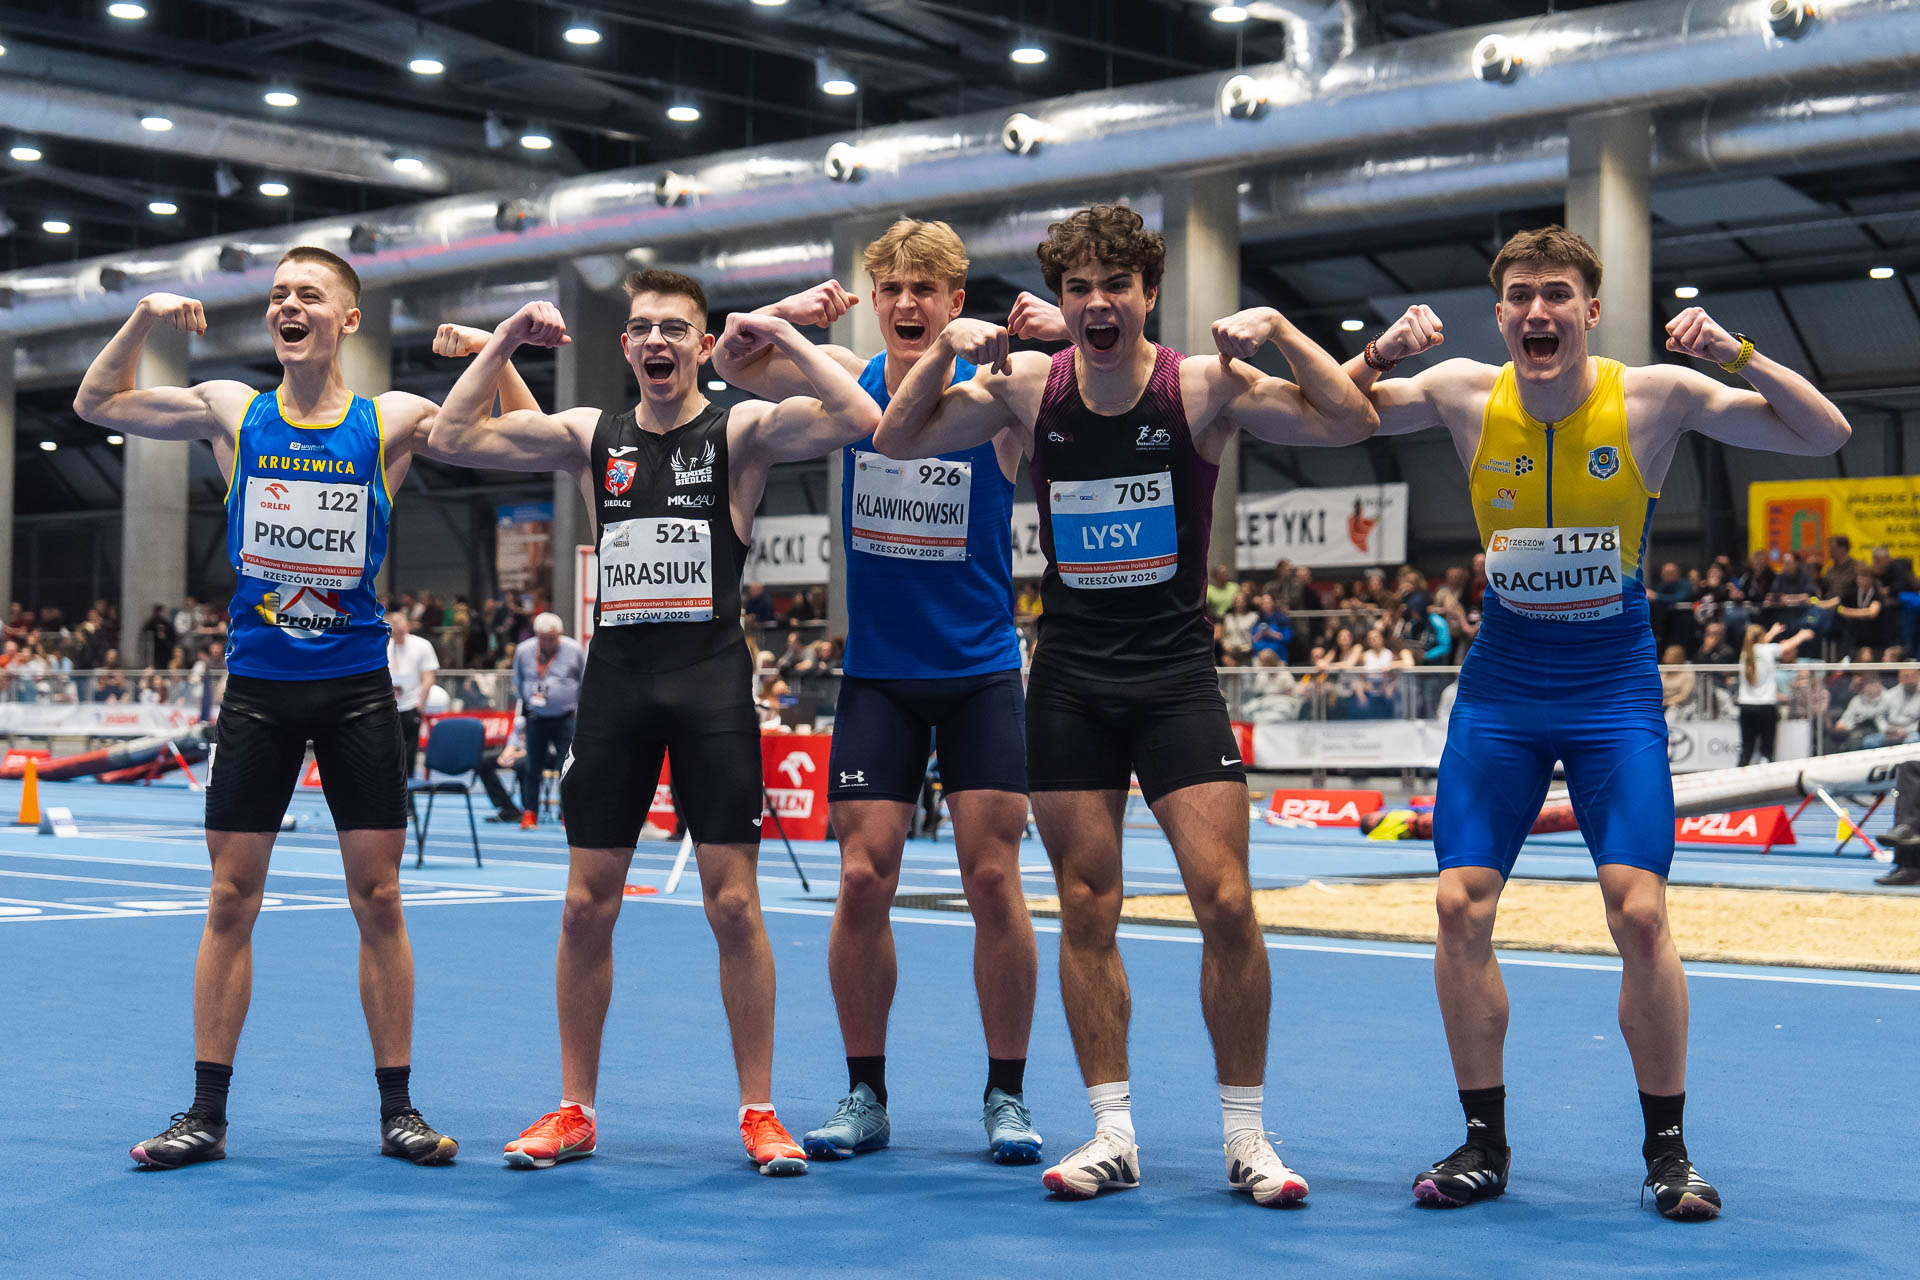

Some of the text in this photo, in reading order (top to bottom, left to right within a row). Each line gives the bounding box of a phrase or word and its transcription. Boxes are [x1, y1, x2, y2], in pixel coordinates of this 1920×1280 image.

[258, 455, 355, 475] KRUSZWICA
[675, 466, 712, 480] FENIKS
[675, 474, 712, 486] SIEDLCE
[919, 465, 961, 486] 926
[317, 490, 358, 513] 122
[1114, 480, 1161, 505] 705
[260, 501, 290, 511] ORLEN
[604, 499, 631, 507] SIEDLCE
[856, 493, 964, 524] KLAWIKOWSKI
[255, 521, 356, 553] PROCEK
[656, 523, 700, 543] 521
[1082, 522, 1141, 550] LYSY
[1509, 538, 1544, 547] rzeszów
[870, 543, 944, 557] RZESZÓW 2026
[1553, 532, 1616, 554] 1178
[247, 556, 259, 564] PZLA
[260, 558, 281, 568] Halowe
[281, 562, 318, 573] Mistrzostwa
[318, 566, 336, 575] Polski
[604, 561, 707, 588] TARASIUK
[1094, 563, 1130, 571] Mistrzostwa
[1131, 561, 1148, 570] Polski
[263, 570, 342, 588] RZESZÓW 2026
[1078, 572, 1158, 585] RZESZÓW 2026
[1492, 565, 1617, 592] RACHUTA
[616, 610, 690, 622] RZESZÓW 2026
[1573, 610, 1600, 620] 2026
[1281, 799, 1360, 822] PZLA
